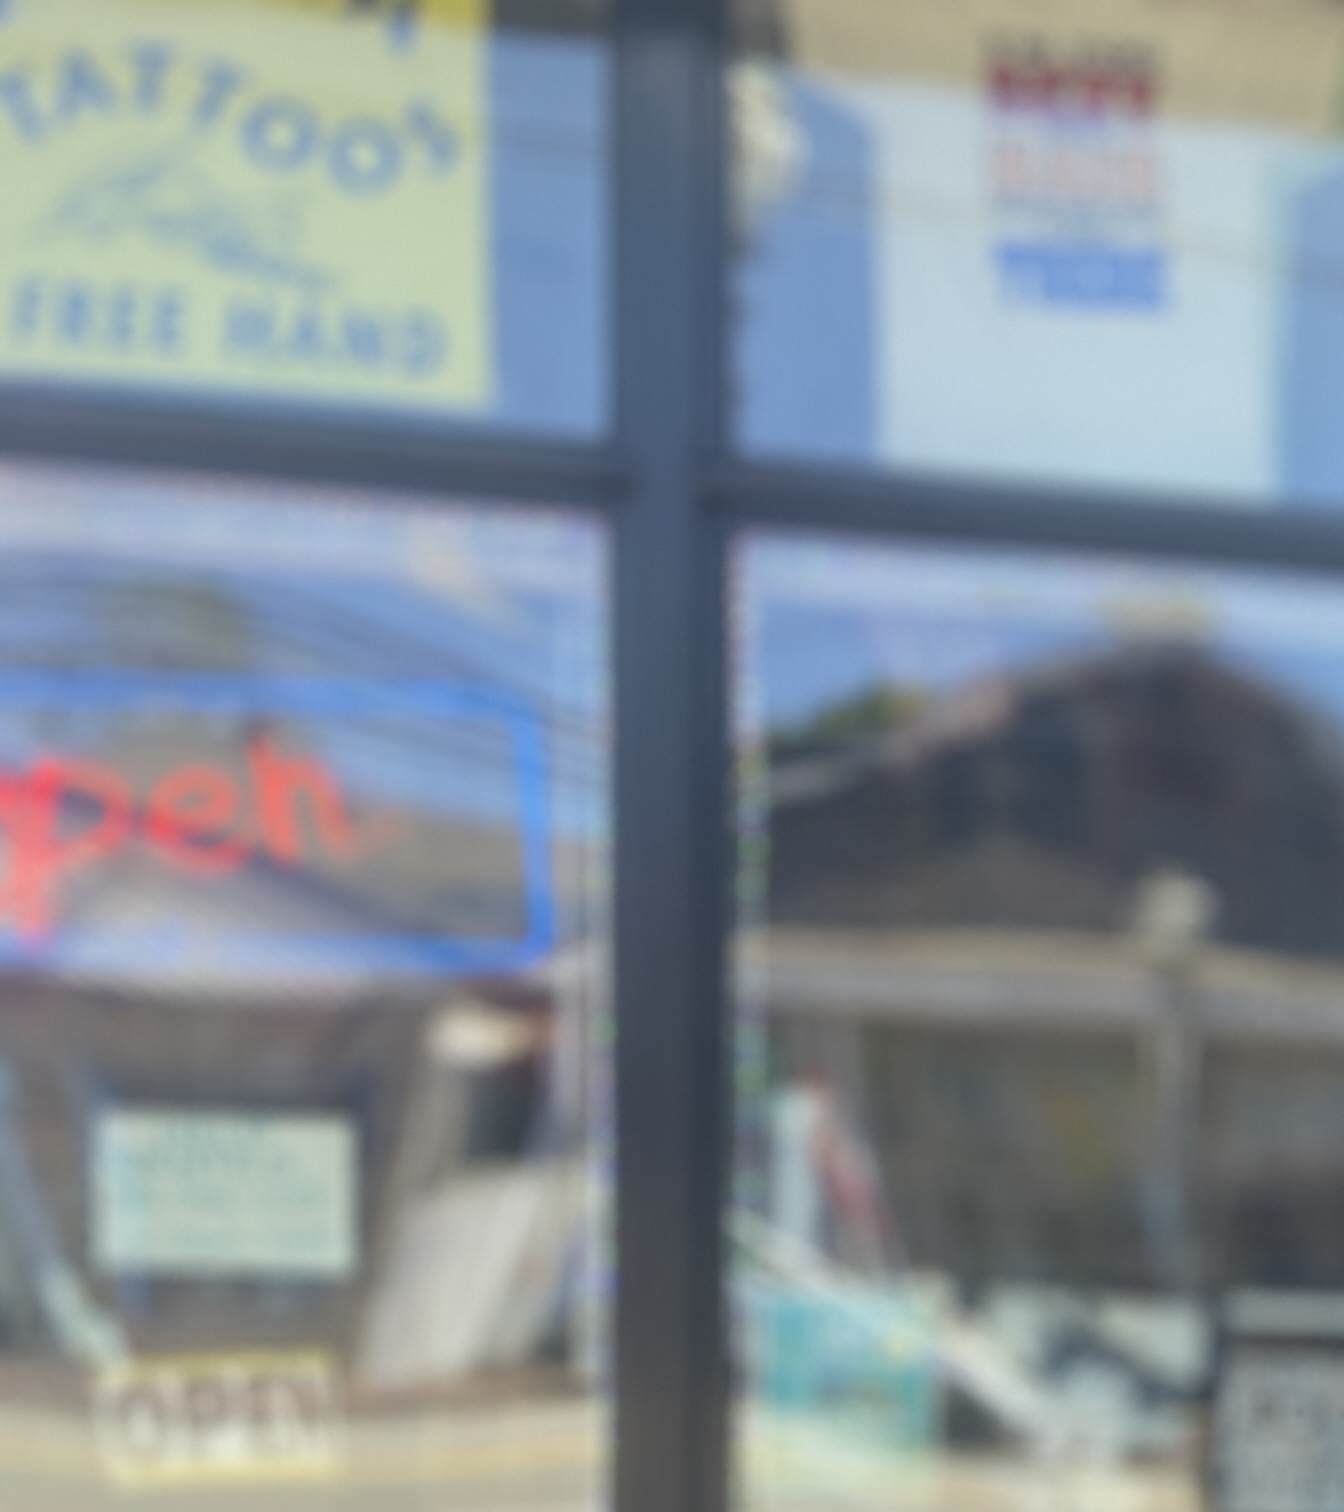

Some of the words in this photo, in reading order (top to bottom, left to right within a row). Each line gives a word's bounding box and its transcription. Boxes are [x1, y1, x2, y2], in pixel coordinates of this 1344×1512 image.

[10, 276, 192, 357] FREE
[220, 293, 450, 378] HAND
[0, 735, 394, 948] pen
